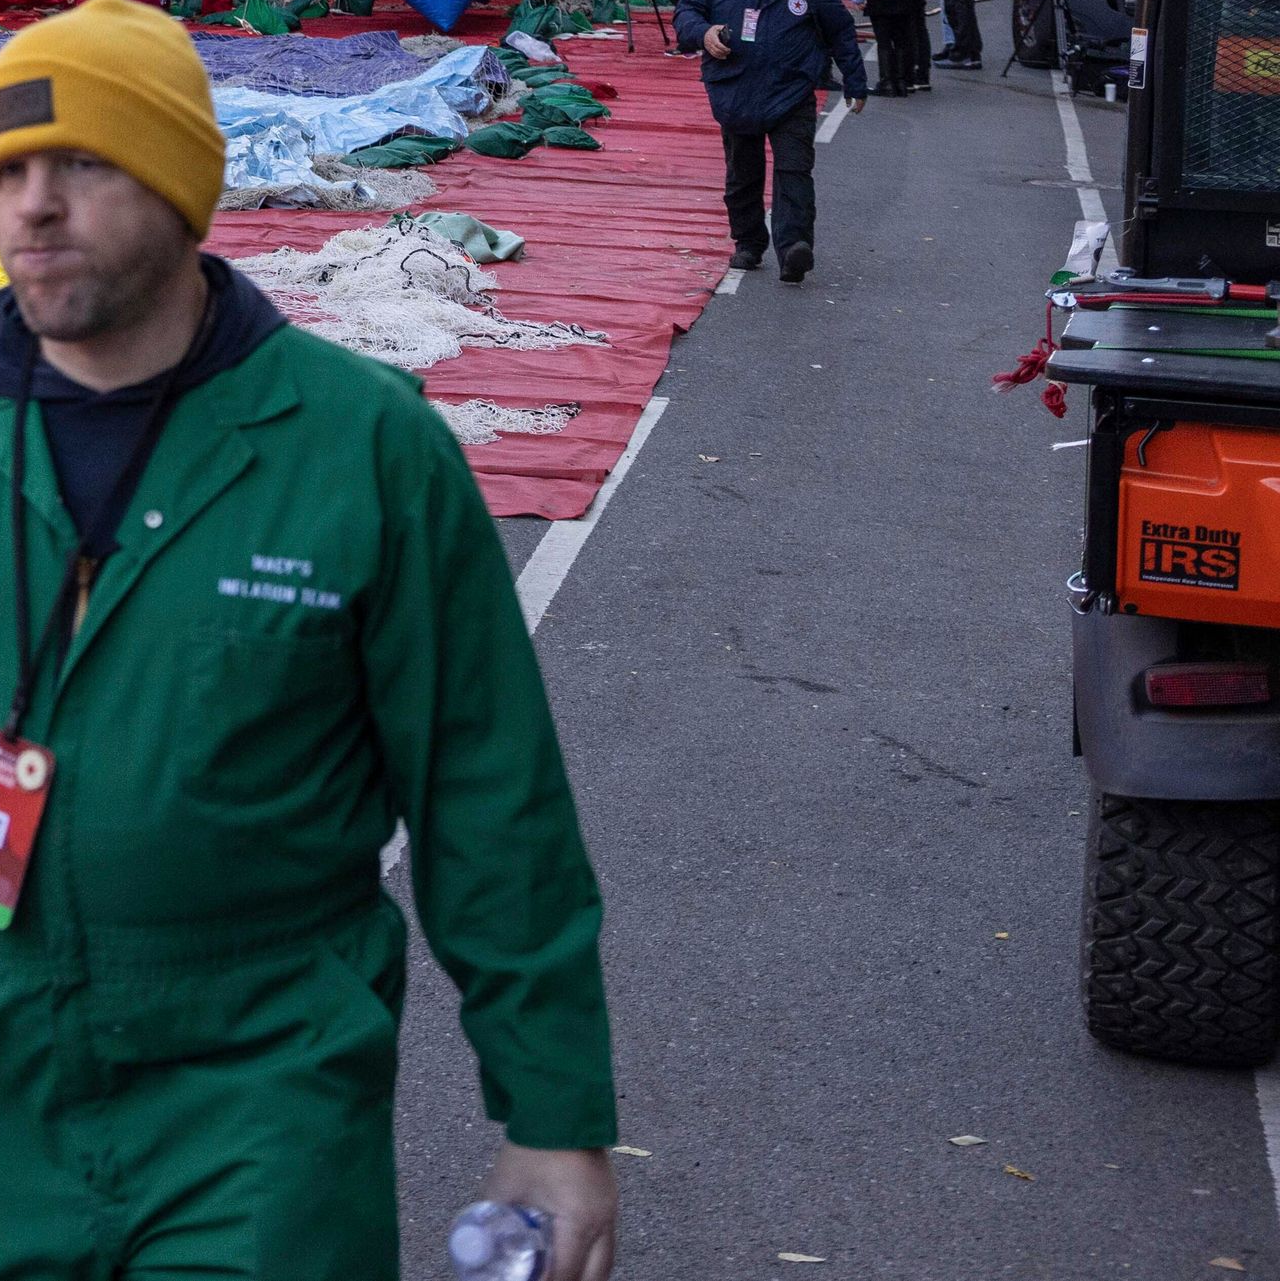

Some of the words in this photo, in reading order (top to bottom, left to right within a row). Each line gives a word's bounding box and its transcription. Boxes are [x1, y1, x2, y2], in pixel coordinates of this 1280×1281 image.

[1142, 520, 1190, 540] Extra
[1195, 525, 1240, 546] Duty
[251, 553, 313, 578] MACY'S
[1144, 542, 1237, 578] IRS
[218, 578, 297, 603] INFLATION
[1142, 574, 1180, 583] Independent
